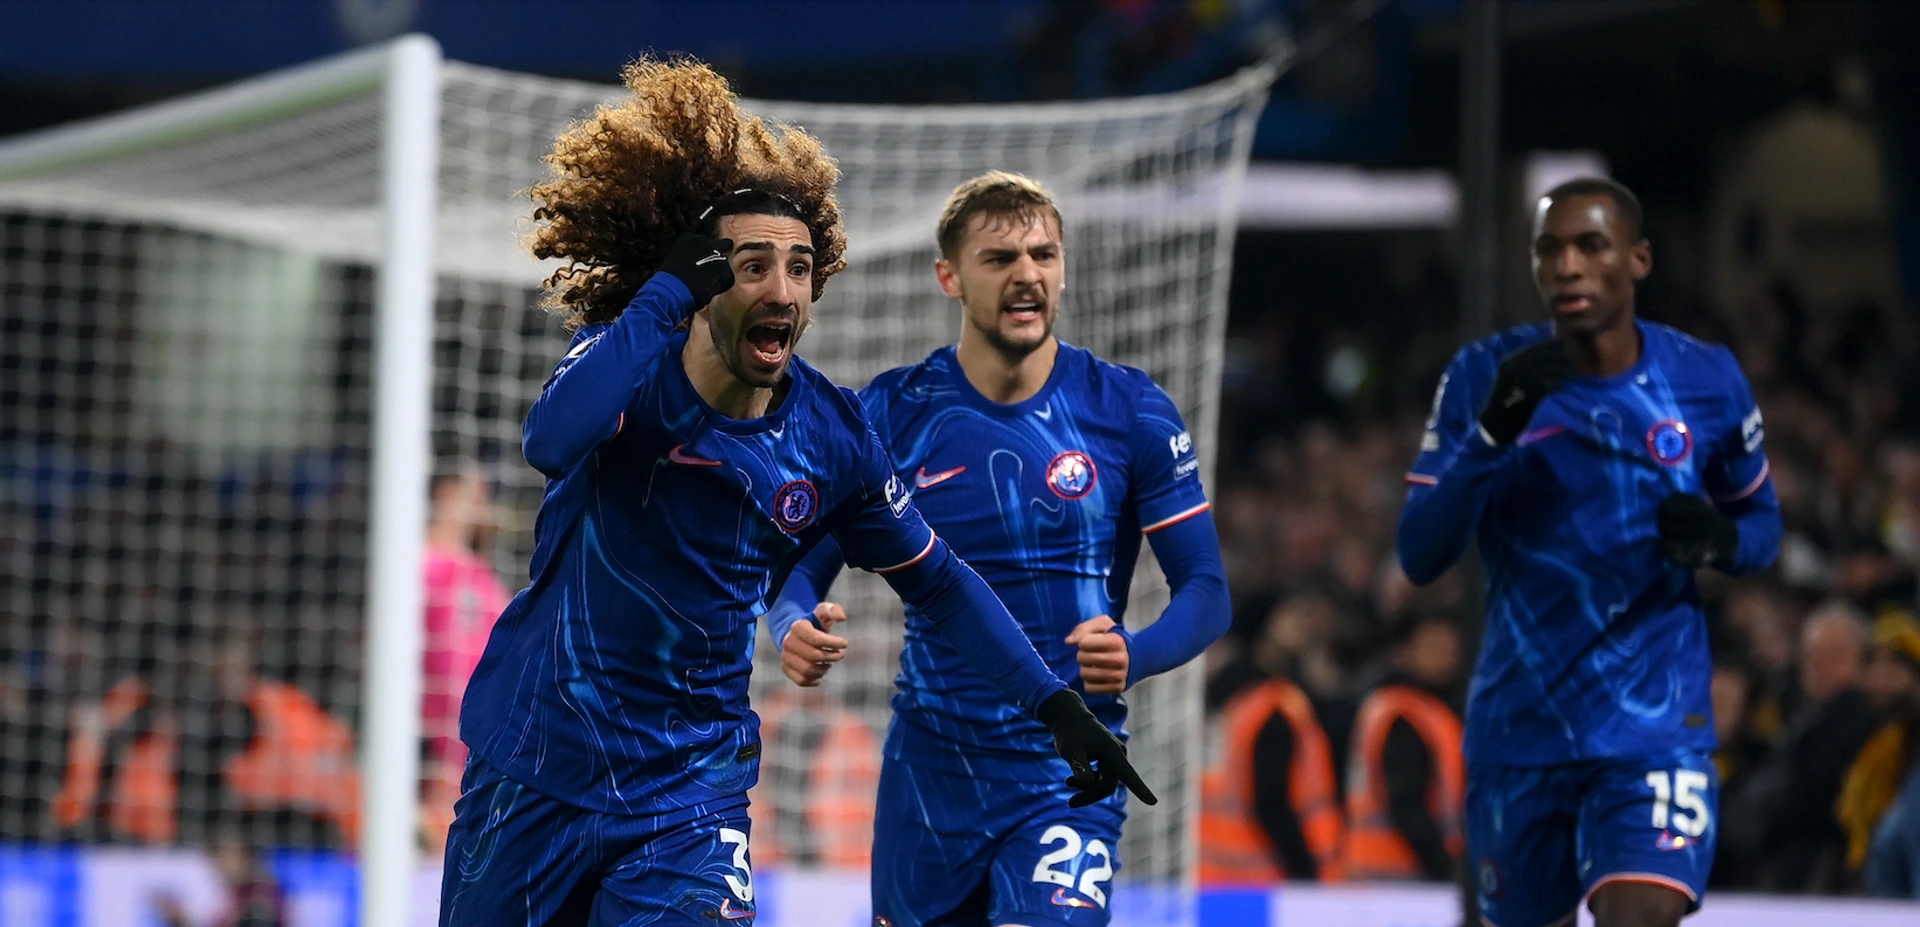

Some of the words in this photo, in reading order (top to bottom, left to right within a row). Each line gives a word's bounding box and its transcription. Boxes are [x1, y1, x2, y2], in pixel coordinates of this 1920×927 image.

[1646, 768, 1708, 837] 15
[719, 828, 753, 902] 3
[1032, 825, 1113, 909] 22
